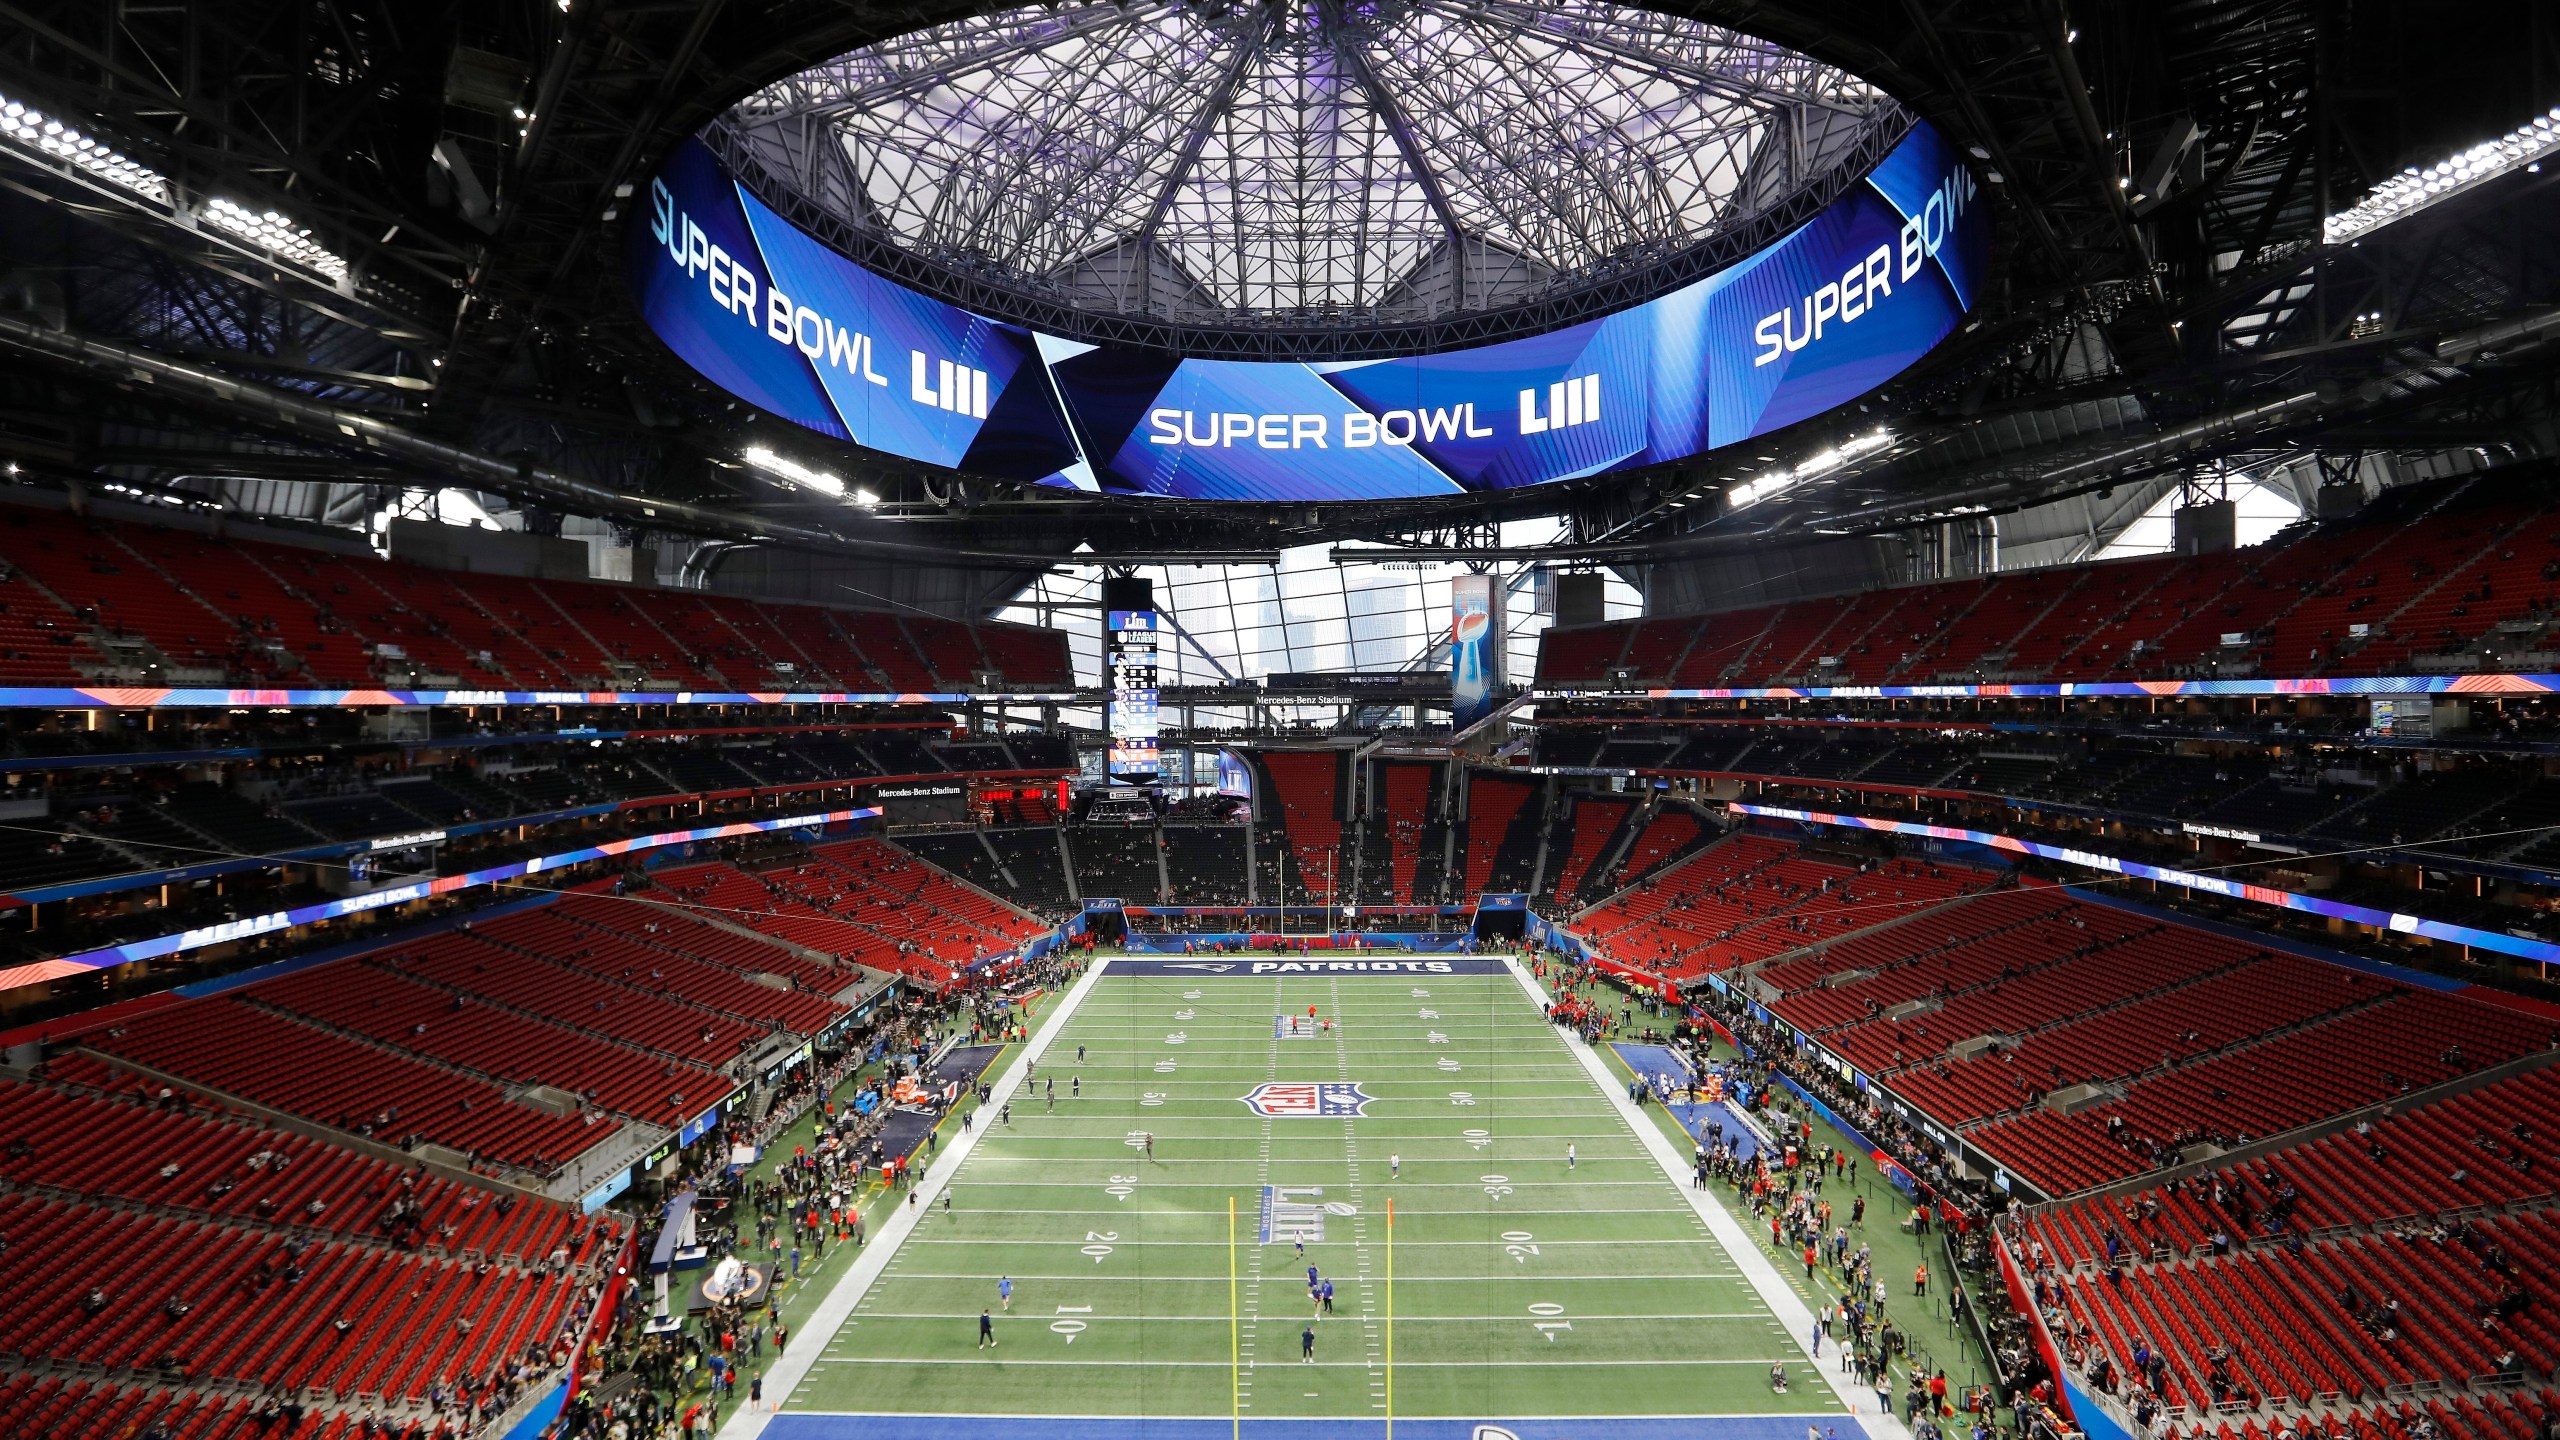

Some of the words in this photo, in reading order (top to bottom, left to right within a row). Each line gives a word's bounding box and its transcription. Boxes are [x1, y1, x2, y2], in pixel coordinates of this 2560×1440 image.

[1755, 244, 1892, 368] SUPER
[1901, 163, 1977, 284] BOWL
[651, 175, 758, 328] SUPER
[767, 287, 888, 388] BOWL
[911, 350, 989, 420] LIII
[1150, 408, 1327, 449] SUPER
[1343, 402, 1494, 448] BOWL
[1519, 373, 1601, 436] LIII
[1256, 695, 1316, 705] Mercedes-Benz
[1318, 695, 1352, 704] Stadium
[1912, 686, 1941, 695] SUPER
[1943, 686, 1969, 695] BOWL
[878, 788, 930, 798] Mercedes-Benz
[931, 786, 960, 795] Stadium
[777, 817, 802, 828] SUPER
[1759, 806, 1784, 817] SUPER
[1784, 809, 1804, 820] BOWL
[371, 836, 419, 850] Mercedes-Benz
[420, 831, 447, 842] Stadium
[2182, 822, 2230, 838] Mercedes-Benz
[2230, 829, 2260, 843] Stadium
[2159, 868, 2196, 887] SUPER
[2197, 875, 2230, 894] BOWL
[342, 891, 385, 913] SUPER
[386, 886, 421, 903] BOWL
[1251, 961, 1453, 974] PATRIOTS
[1822, 1051, 1841, 1073] 90:00
[1842, 1063, 1852, 1081] 40
[1140, 1092, 1167, 1106] 50
[1257, 1086, 1316, 1113] NFL
[1449, 1092, 1476, 1106] 50
[1868, 1085, 1882, 1100] DOWN
[1893, 1101, 1901, 1113] TO
[1900, 1106, 1908, 1118] GO
[1462, 1129, 1493, 1147] 40
[1924, 1122, 1936, 1138] BALL
[1937, 1133, 1946, 1144] ON
[662, 1145, 669, 1157] 3
[1105, 1175, 1138, 1195] 30
[1480, 1174, 1513, 1195] 30
[1263, 1195, 1271, 1216] SUPER
[1262, 1215, 1270, 1232] BOWL
[1080, 1231, 1119, 1256] 20
[1501, 1230, 1540, 1256] 20
[1050, 1304, 1093, 1334] 10
[1528, 1302, 1573, 1332] 10
